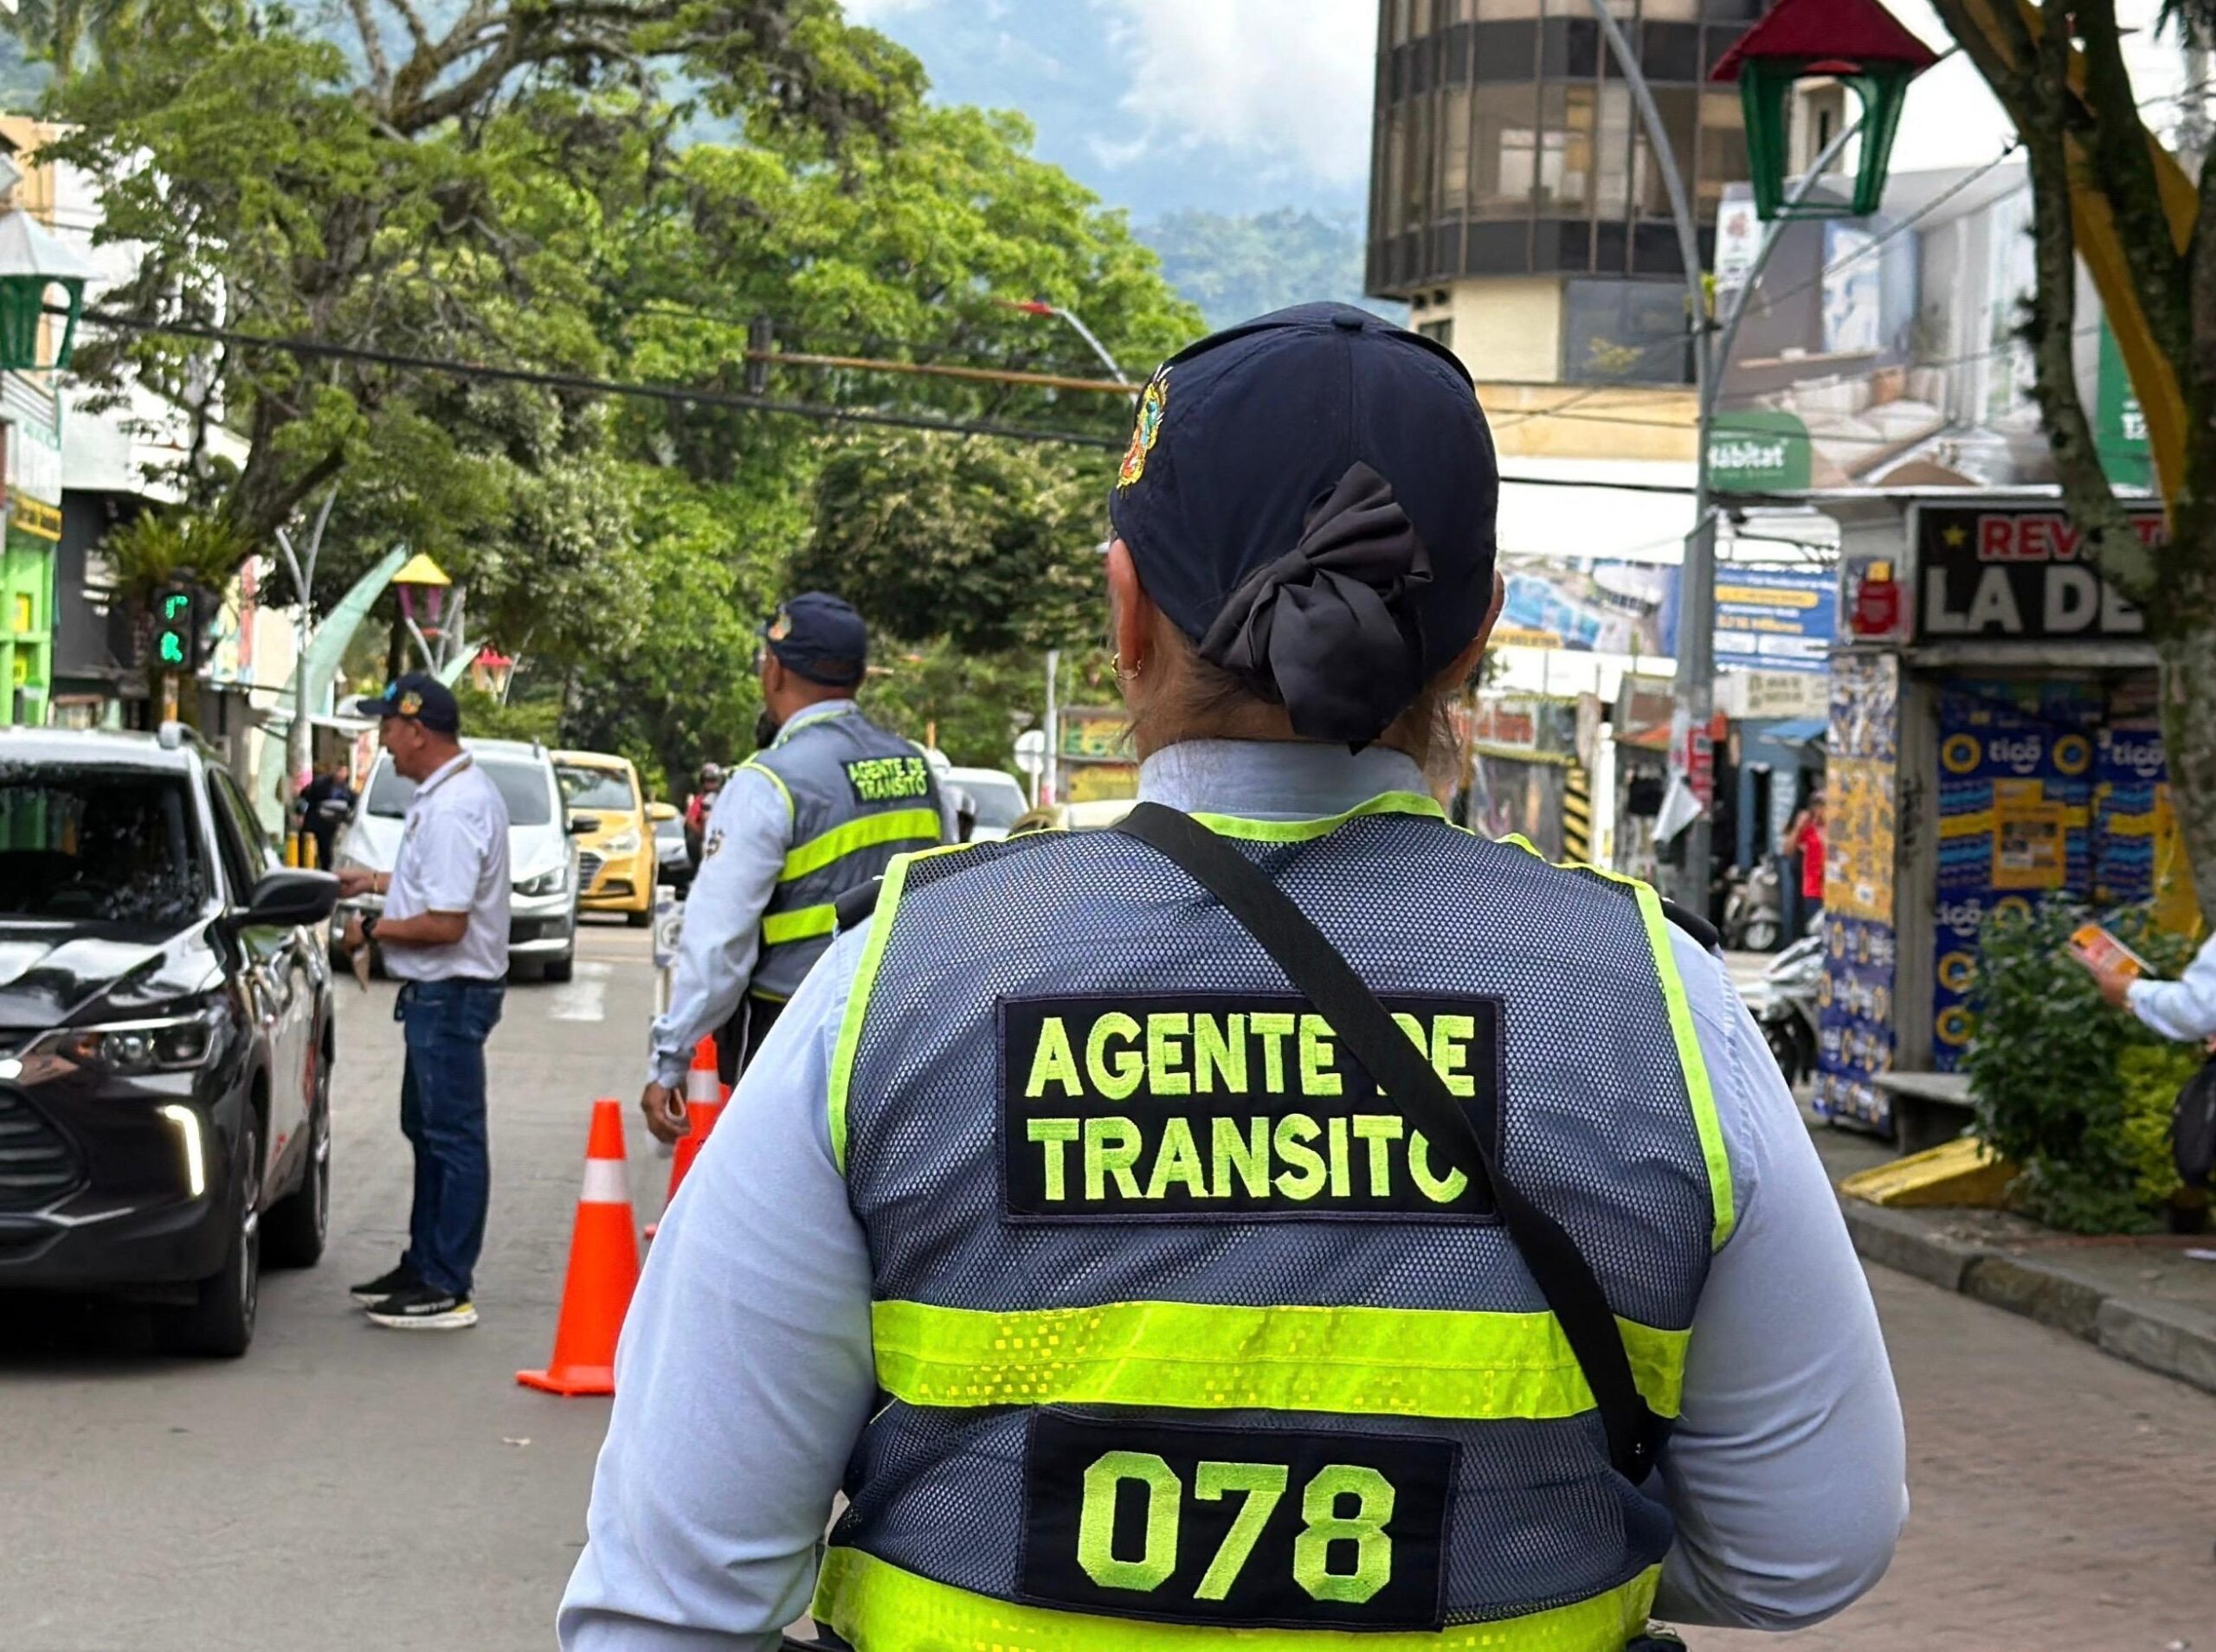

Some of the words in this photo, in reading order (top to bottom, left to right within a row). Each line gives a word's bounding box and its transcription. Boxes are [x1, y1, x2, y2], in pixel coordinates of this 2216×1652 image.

[1925, 565, 2024, 632] LA
[848, 758, 905, 782] AGENTE
[905, 757, 927, 776] DE
[857, 775, 927, 800] TRANSITO
[1025, 1011, 1343, 1100] AGENTE
[1077, 1450, 1395, 1604] 078
